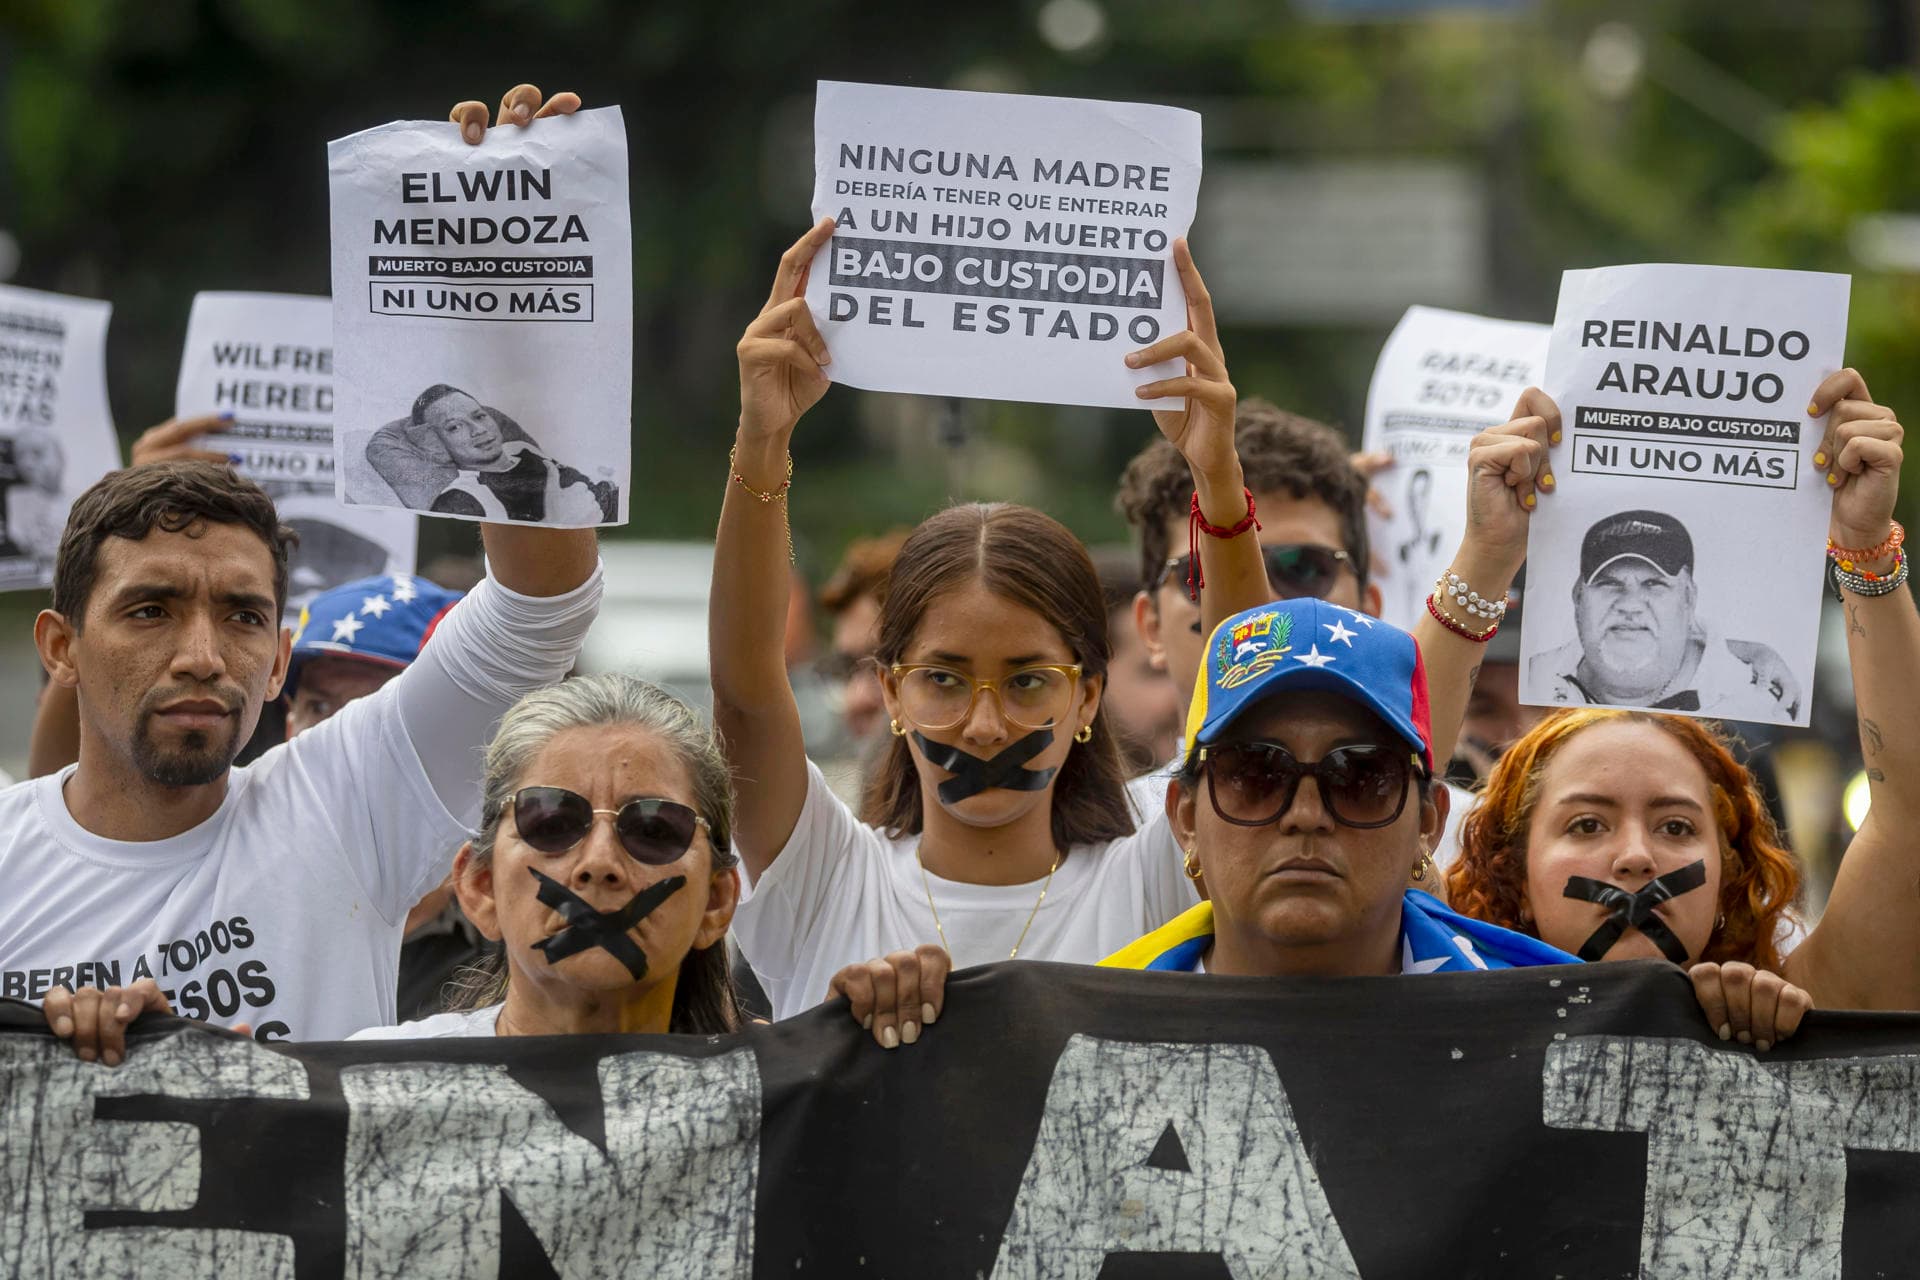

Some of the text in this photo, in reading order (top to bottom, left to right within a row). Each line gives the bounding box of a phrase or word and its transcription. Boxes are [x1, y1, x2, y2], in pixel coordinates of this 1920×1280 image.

[402, 169, 551, 203] ELWIN
[839, 143, 1171, 192] NINGUNA MADRE
[835, 179, 1168, 219] DEBERÍA TENER QUE ENTERRAR
[374, 214, 589, 245] MENDOZA
[834, 207, 1168, 252] A UN HIJO MUERTO
[377, 260, 586, 273] MUERTO BAJO CUSTODIA
[836, 248, 1158, 298] BAJO CUSTODIA
[383, 288, 581, 314] NI UNO MÁS
[829, 292, 1161, 345] DEL ESTADO
[1581, 320, 1810, 361] REINALDO
[1596, 362, 1784, 404] ARAUJO
[1583, 411, 1793, 438] MUERTO BAJO CUSTODIA
[1586, 444, 1785, 480] NI UNO MÁS
[132, 953, 154, 979] A
[158, 916, 255, 976] TODOS
